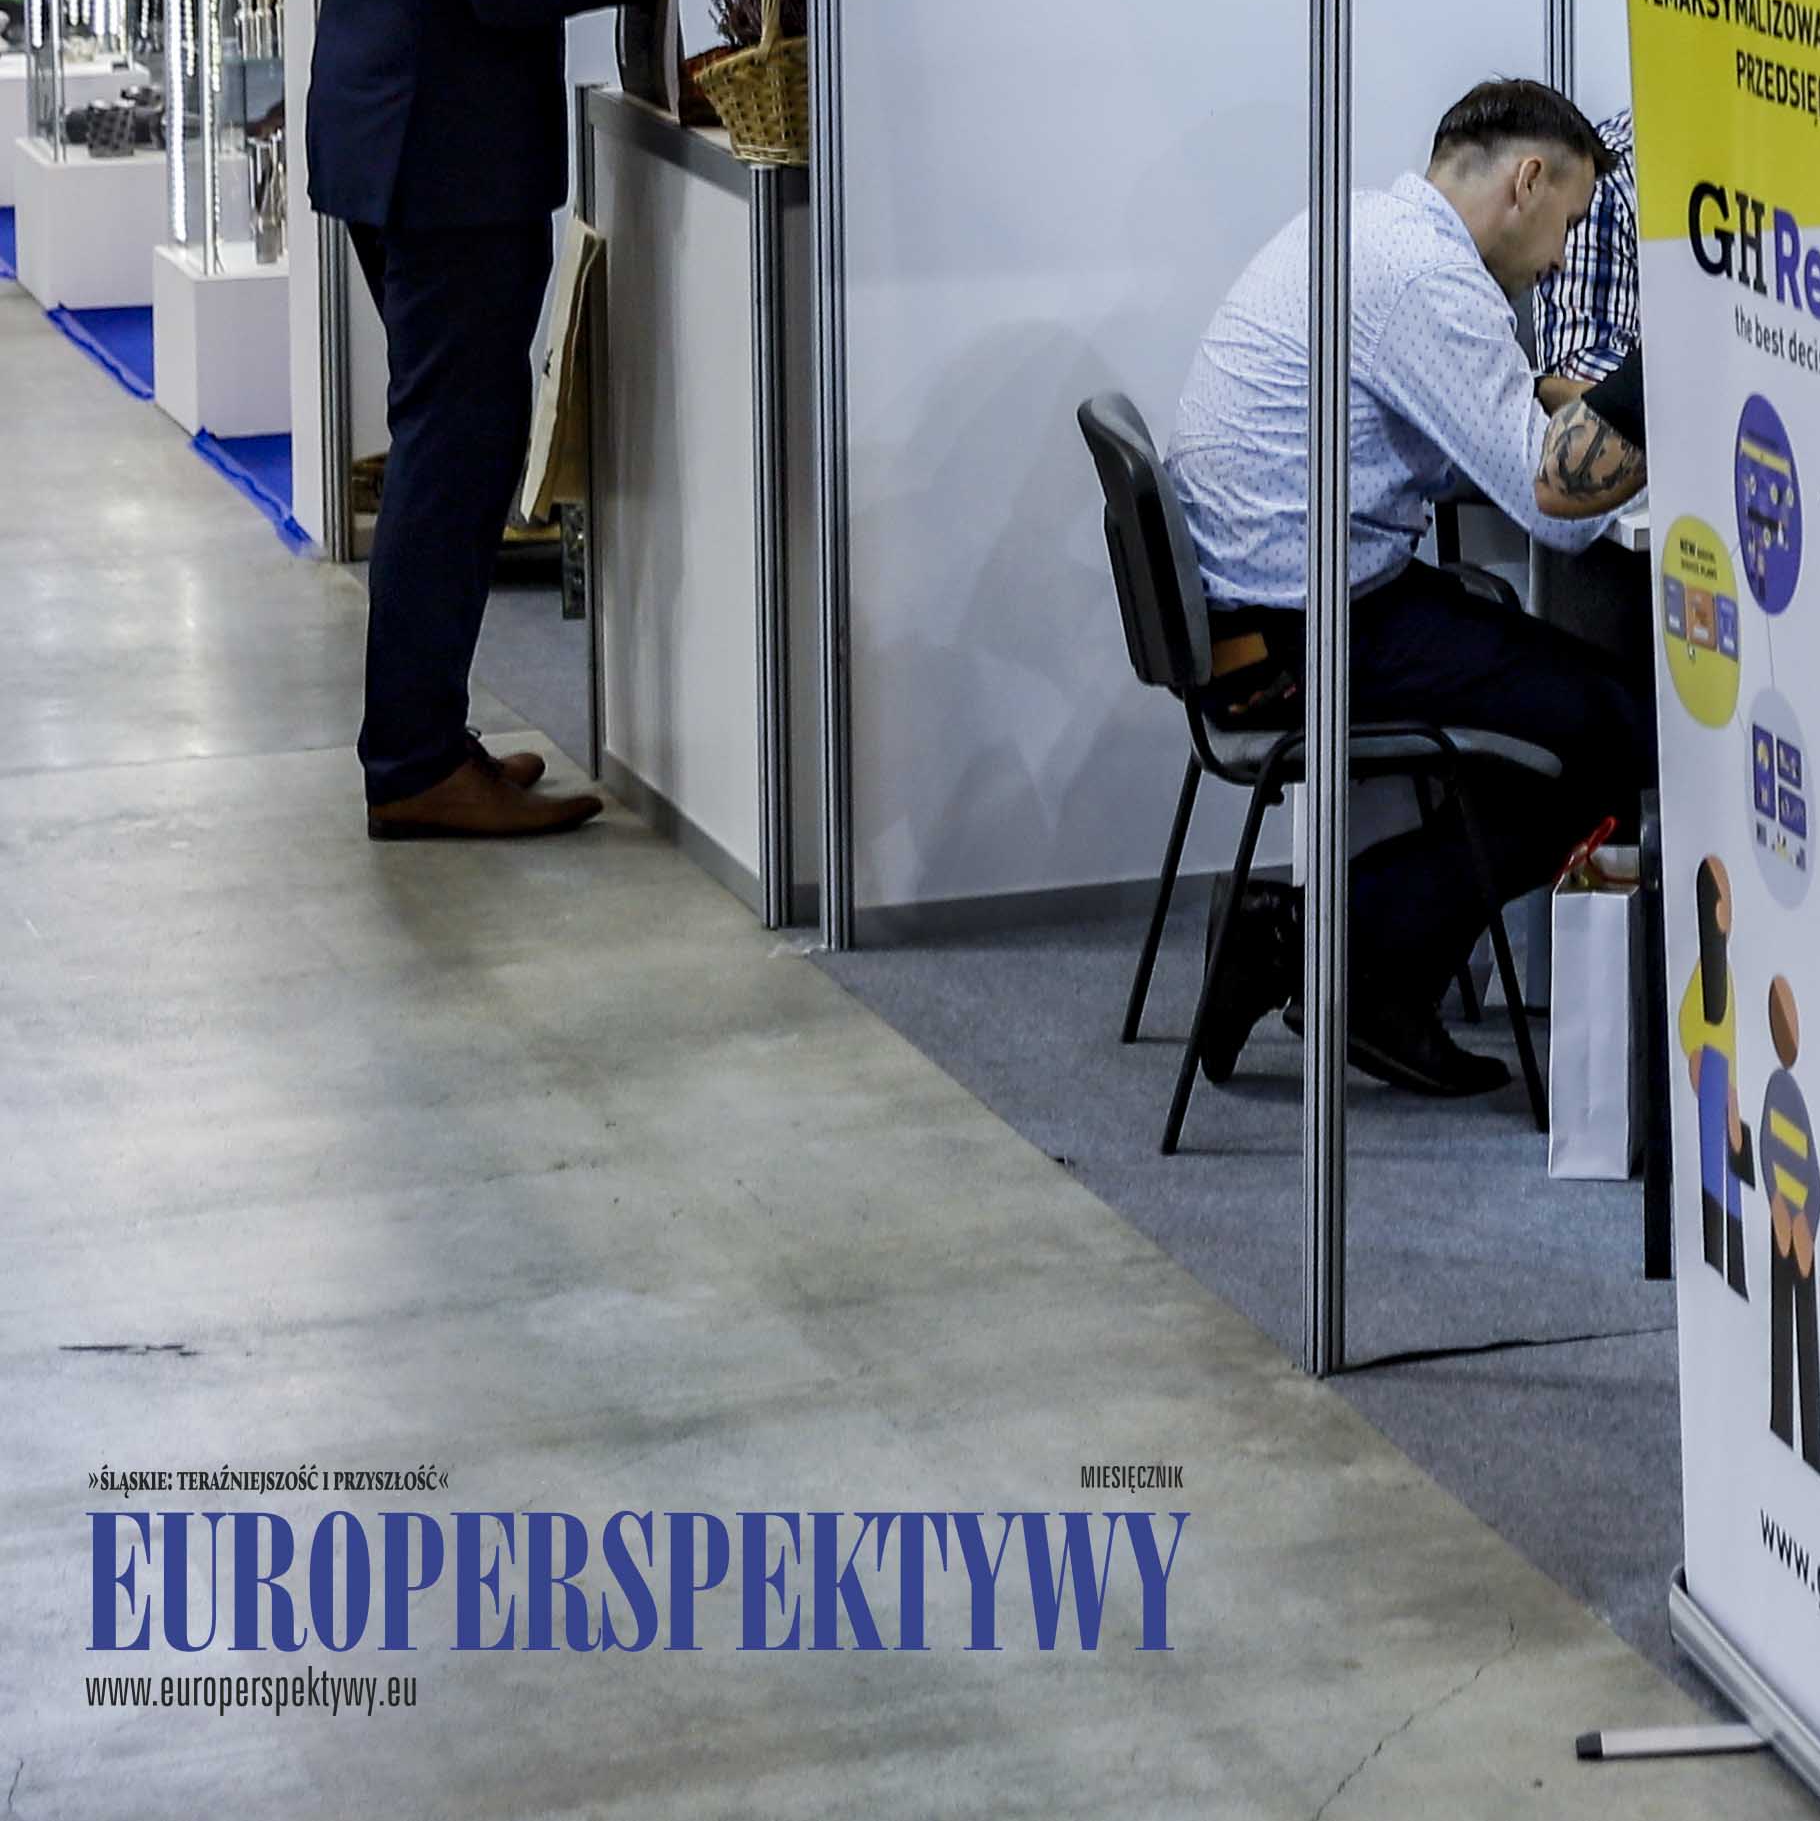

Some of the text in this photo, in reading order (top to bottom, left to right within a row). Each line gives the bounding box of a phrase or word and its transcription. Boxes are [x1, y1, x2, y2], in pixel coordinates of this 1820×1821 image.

[1688, 181, 1767, 295] GH
[1735, 305, 1753, 342] the
[1755, 317, 1785, 359] best
